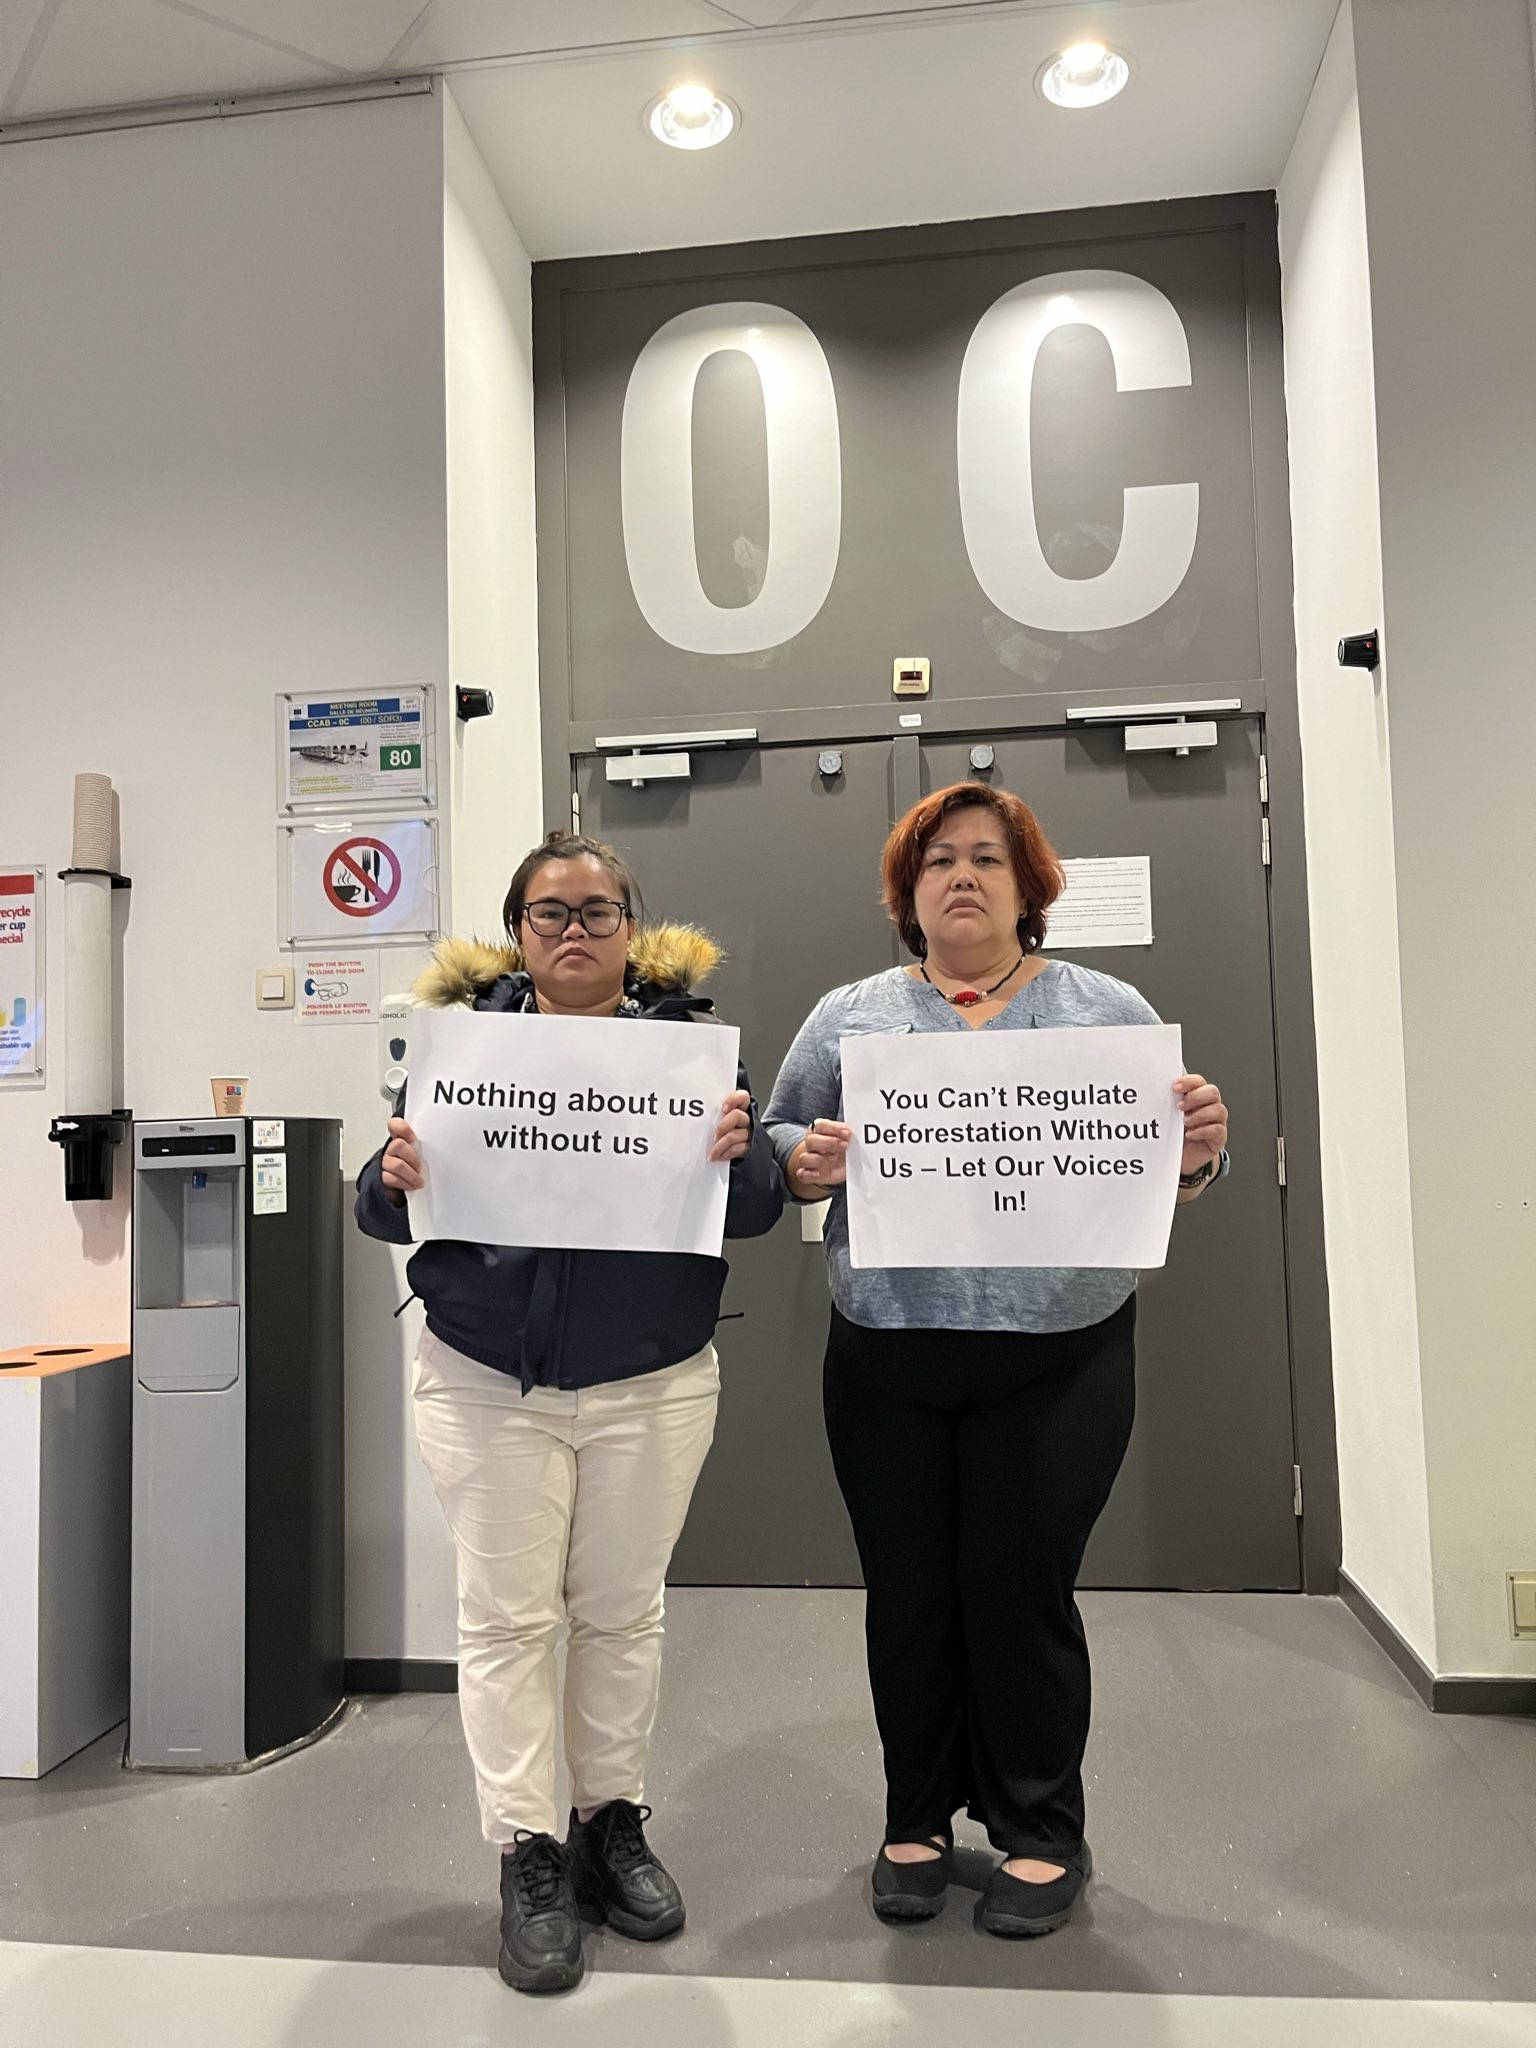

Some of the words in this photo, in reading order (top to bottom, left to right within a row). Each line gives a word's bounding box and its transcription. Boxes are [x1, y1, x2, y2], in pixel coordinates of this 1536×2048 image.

[330, 702, 357, 710] MEETING
[358, 700, 378, 708] ROOM
[307, 719, 331, 728] CCAB
[389, 749, 412, 766] 80
[9, 922, 26, 932] cup
[433, 1080, 557, 1117] Nothing
[567, 1088, 659, 1116] about
[668, 1098, 705, 1118] us
[879, 1088, 929, 1111] You
[937, 1086, 1008, 1109] Can’t
[1016, 1083, 1138, 1112] Regulate
[483, 1125, 602, 1153] without
[612, 1135, 649, 1155] us
[863, 1121, 1043, 1145] Deforestation
[1050, 1118, 1160, 1142] Without
[879, 1157, 913, 1178] Us
[945, 1156, 987, 1178] Let
[994, 1155, 1045, 1177] Our
[1053, 1154, 1145, 1176] Voices
[993, 1190, 1027, 1212] In!
